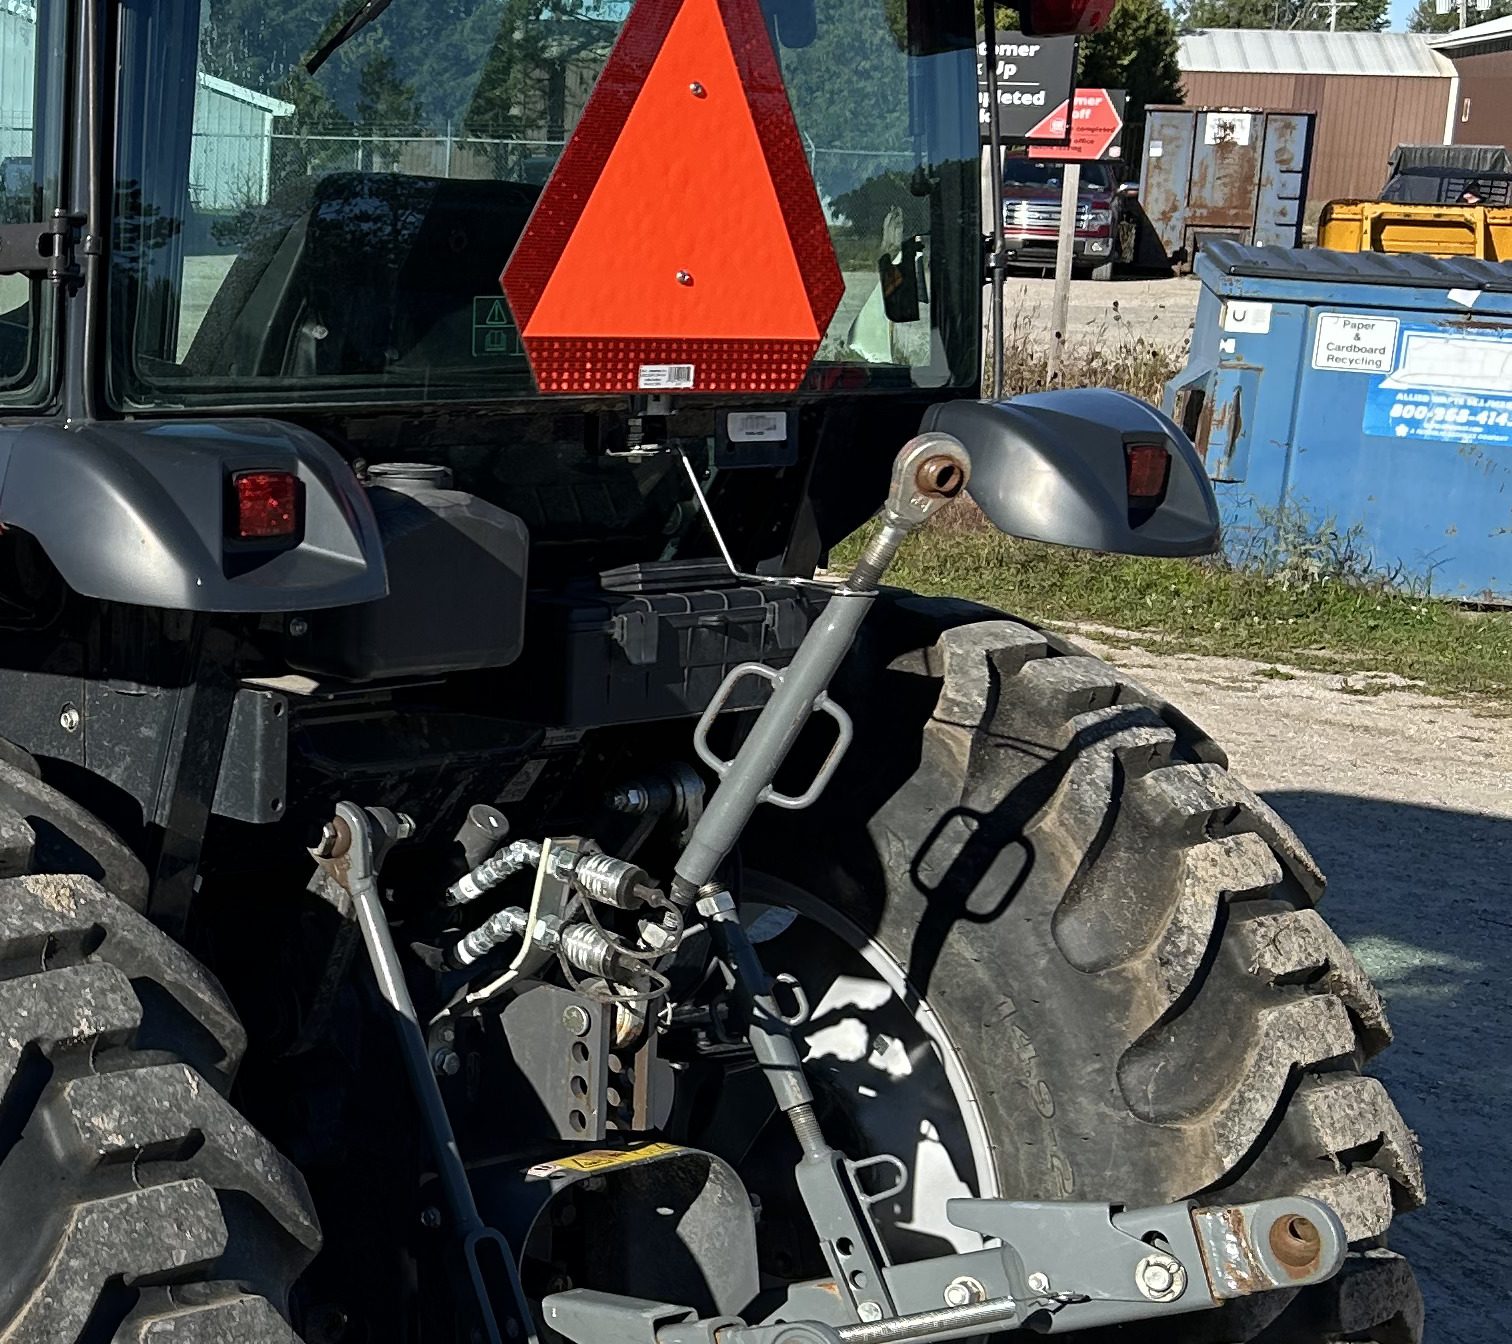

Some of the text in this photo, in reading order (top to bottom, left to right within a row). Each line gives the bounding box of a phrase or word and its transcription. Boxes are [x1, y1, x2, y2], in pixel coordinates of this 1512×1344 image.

[1343, 319, 1376, 332] Paper
[1353, 332, 1361, 341] &
[1326, 342, 1387, 355] Cardboard
[1326, 354, 1383, 369] Recycling
